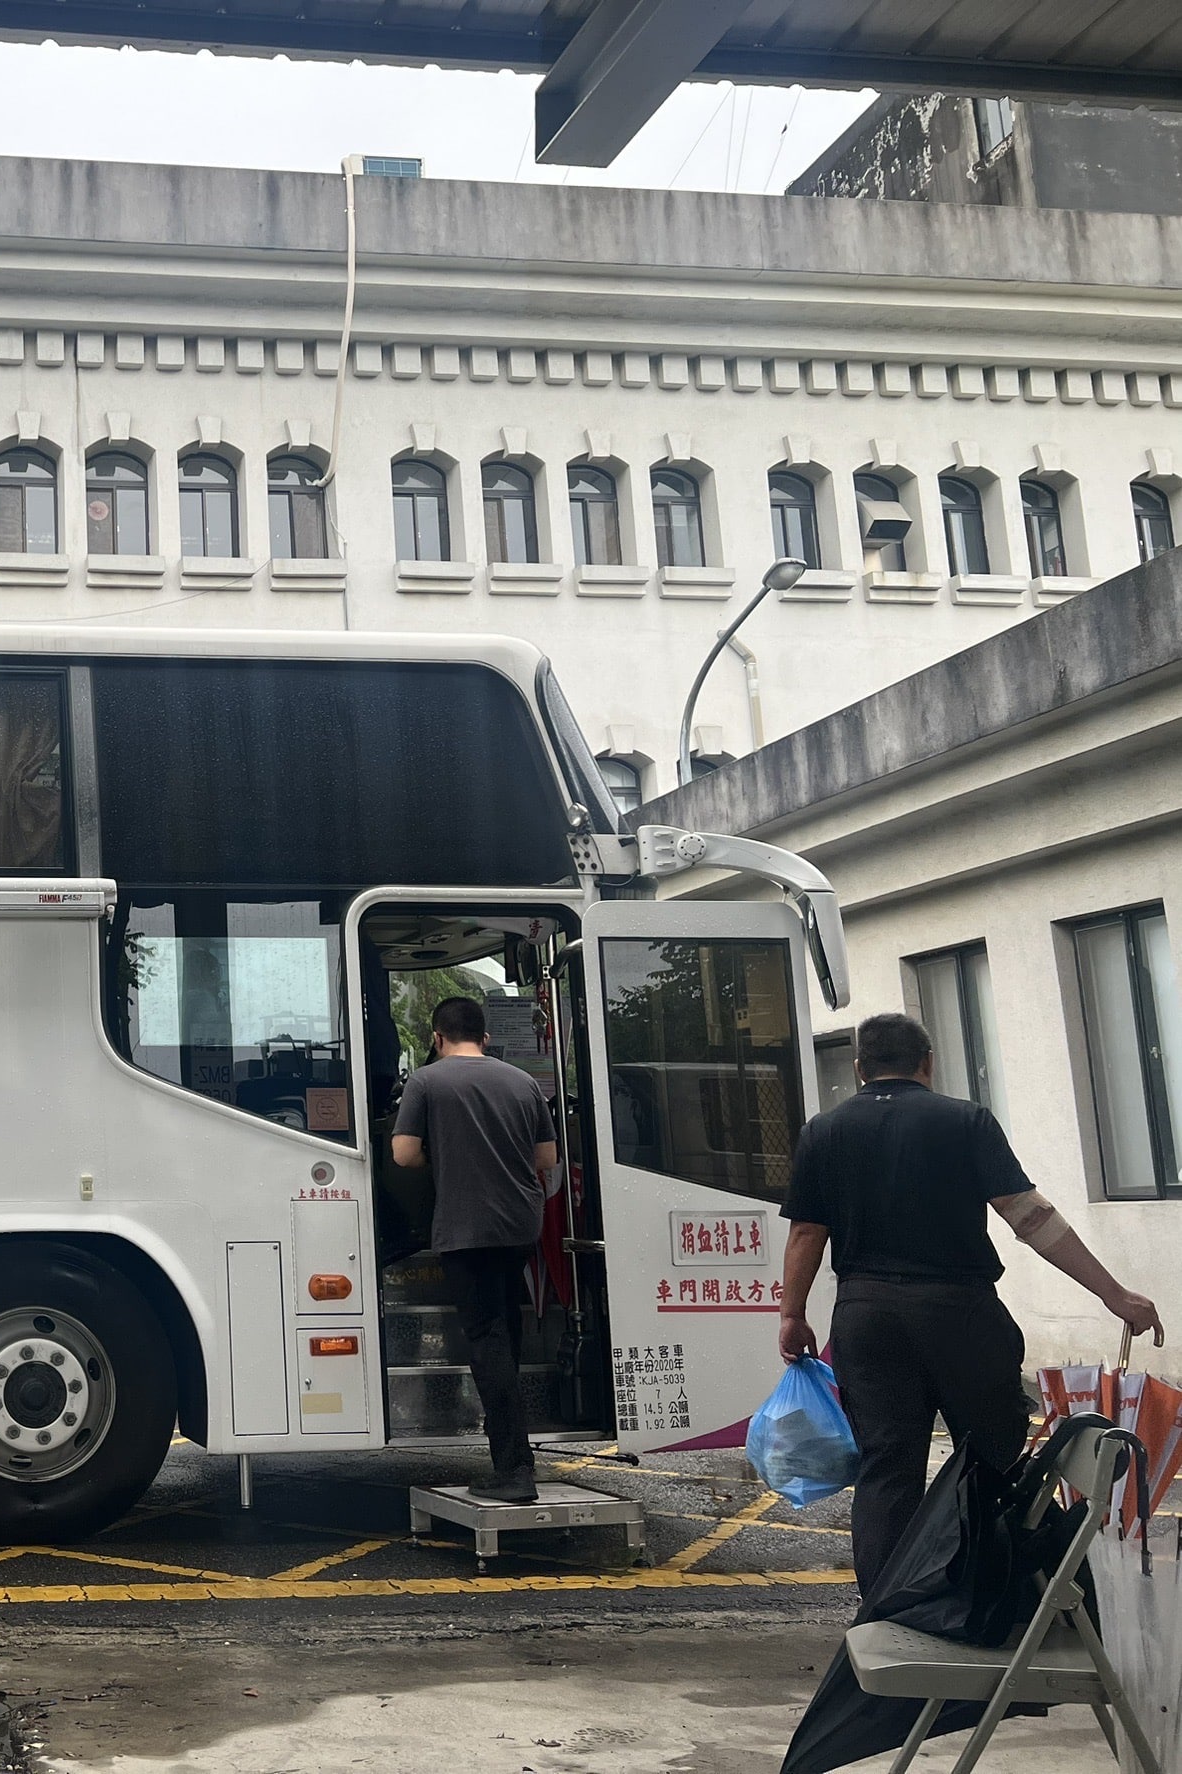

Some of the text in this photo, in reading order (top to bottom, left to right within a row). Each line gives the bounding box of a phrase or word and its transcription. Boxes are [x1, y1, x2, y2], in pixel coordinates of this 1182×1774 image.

[681, 1220, 762, 1256] 捐血請上車
[612, 1344, 684, 1360] 甲類大客車
[617, 1389, 637, 1402] 座位
[677, 1386, 688, 1400] 人
[643, 1403, 663, 1415] 14.5
[645, 1418, 665, 1430] 1.92
